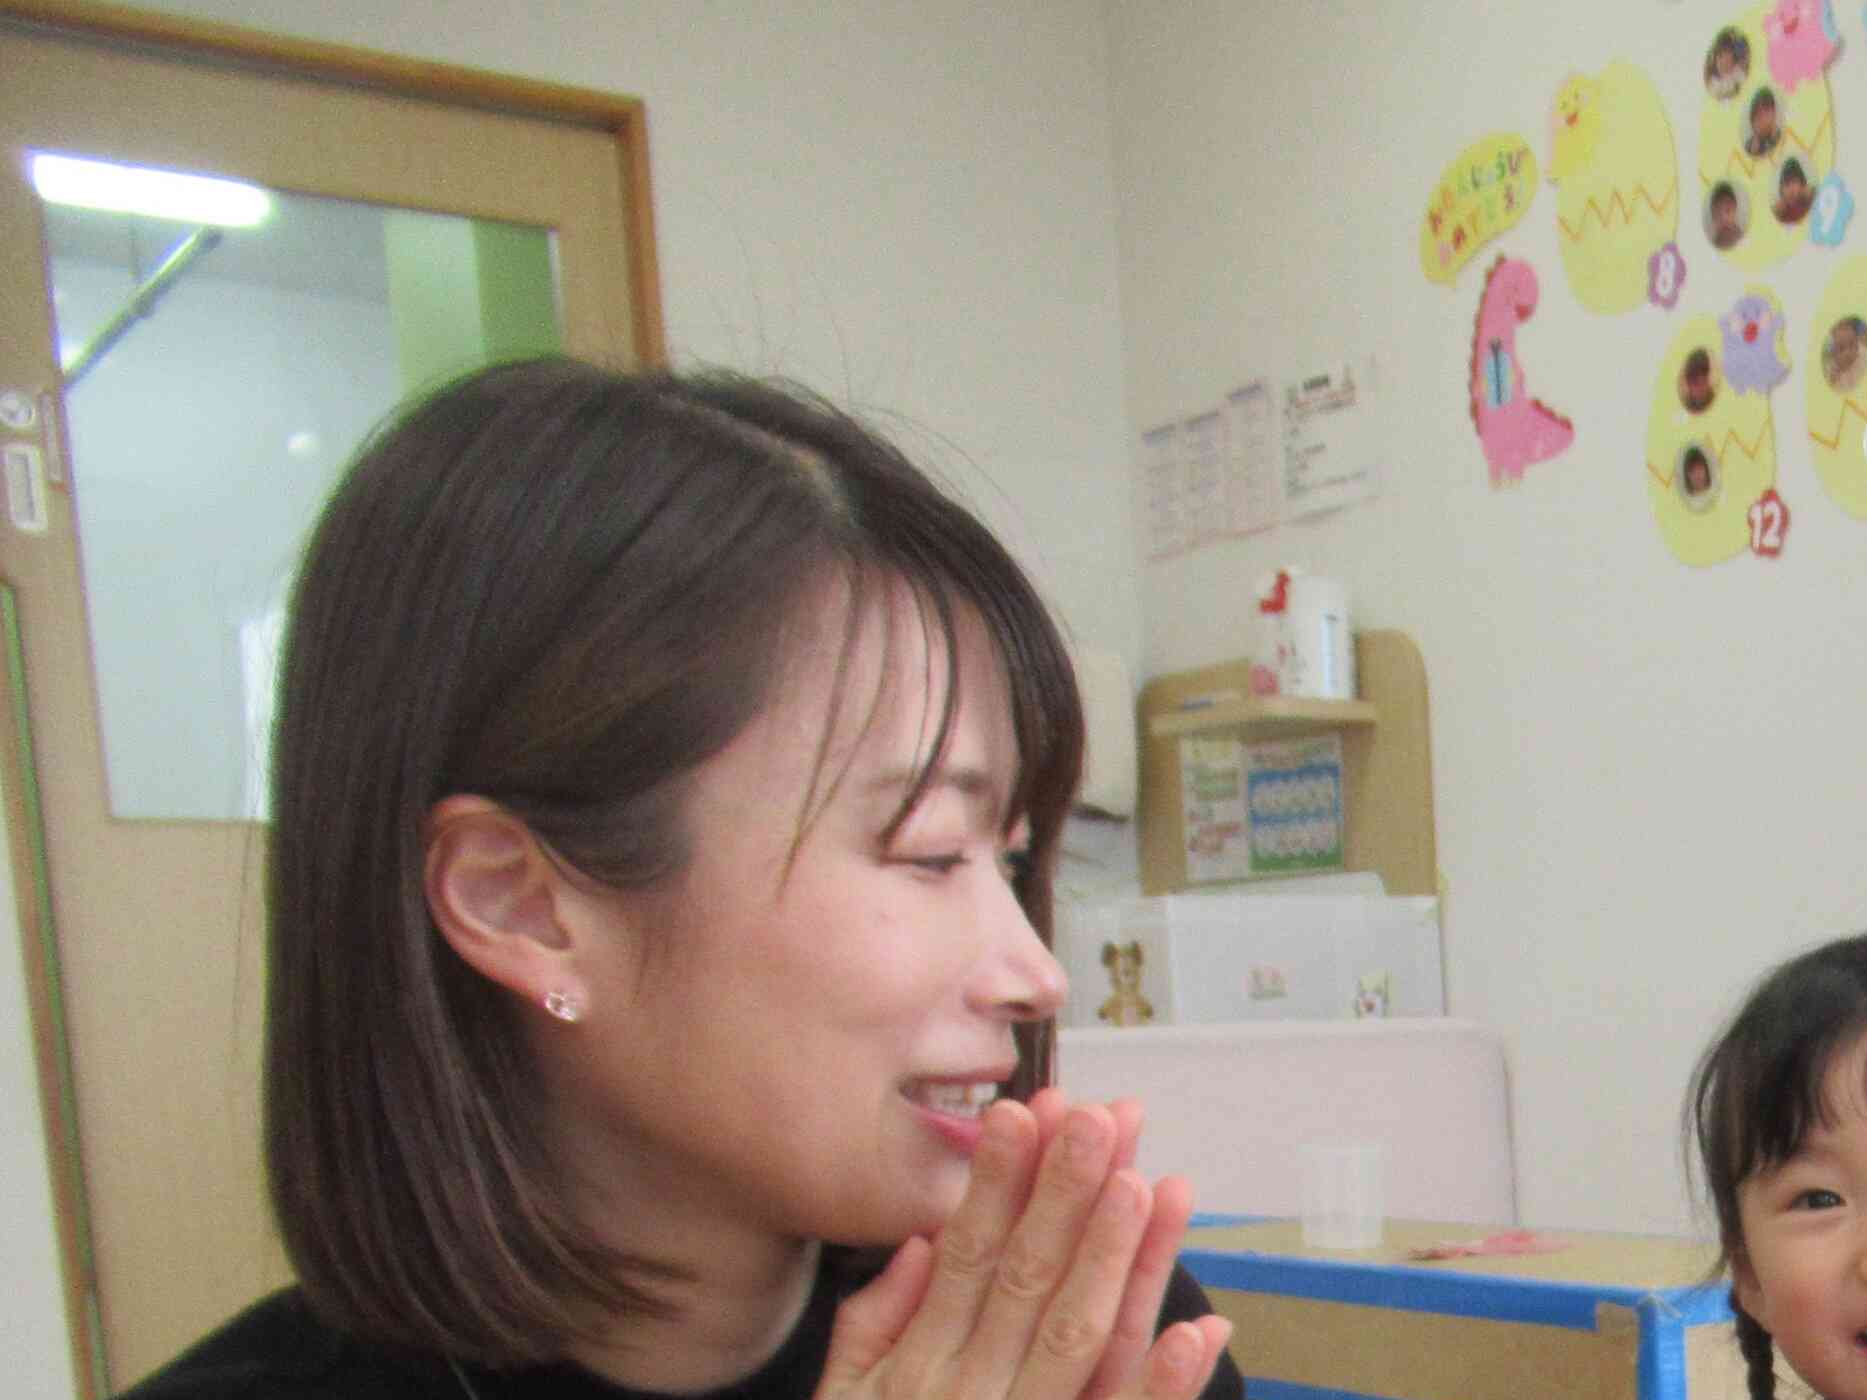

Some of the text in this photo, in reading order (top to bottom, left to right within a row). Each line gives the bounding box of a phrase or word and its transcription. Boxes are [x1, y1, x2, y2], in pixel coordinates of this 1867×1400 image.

[1819, 184, 1841, 234] 9
[1657, 250, 1677, 298] 8
[1750, 500, 1780, 548] 12
